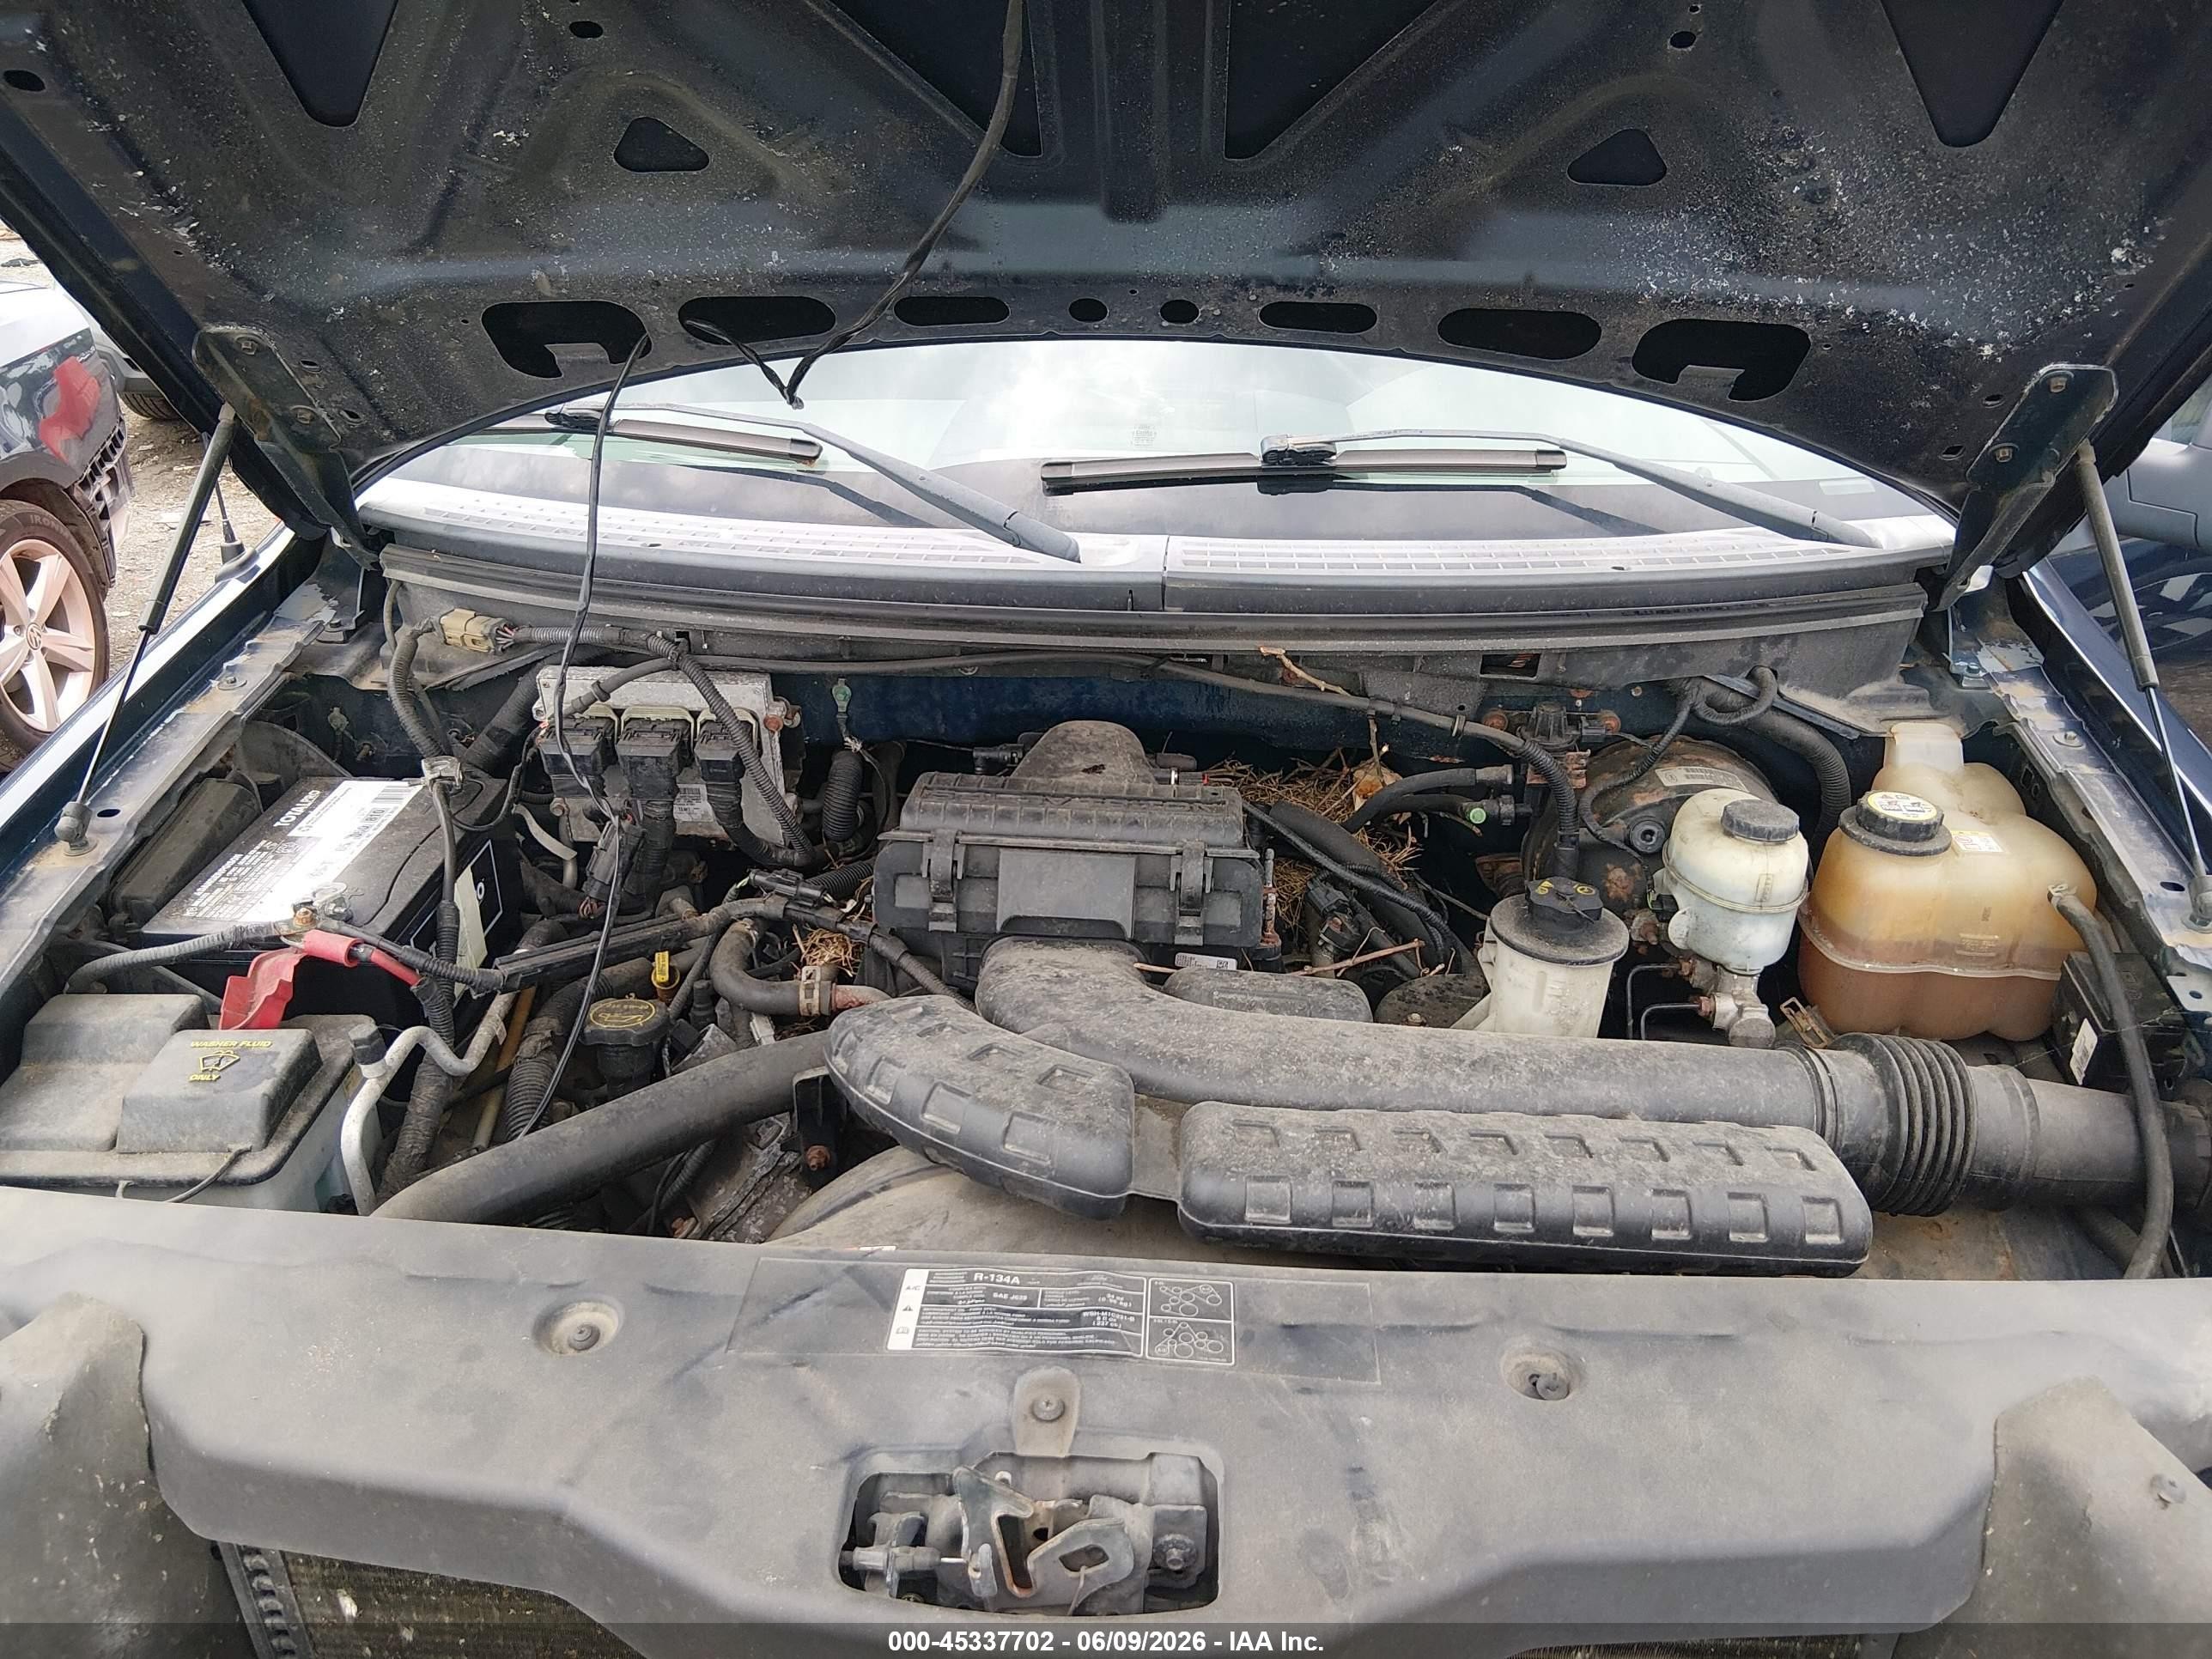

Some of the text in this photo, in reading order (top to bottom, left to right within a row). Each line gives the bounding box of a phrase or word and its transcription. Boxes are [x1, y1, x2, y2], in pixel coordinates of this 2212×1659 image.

[272, 789, 321, 827] TOTALPRO
[188, 1073, 221, 1082] ONLY
[973, 1272, 1020, 1285] R-134A
